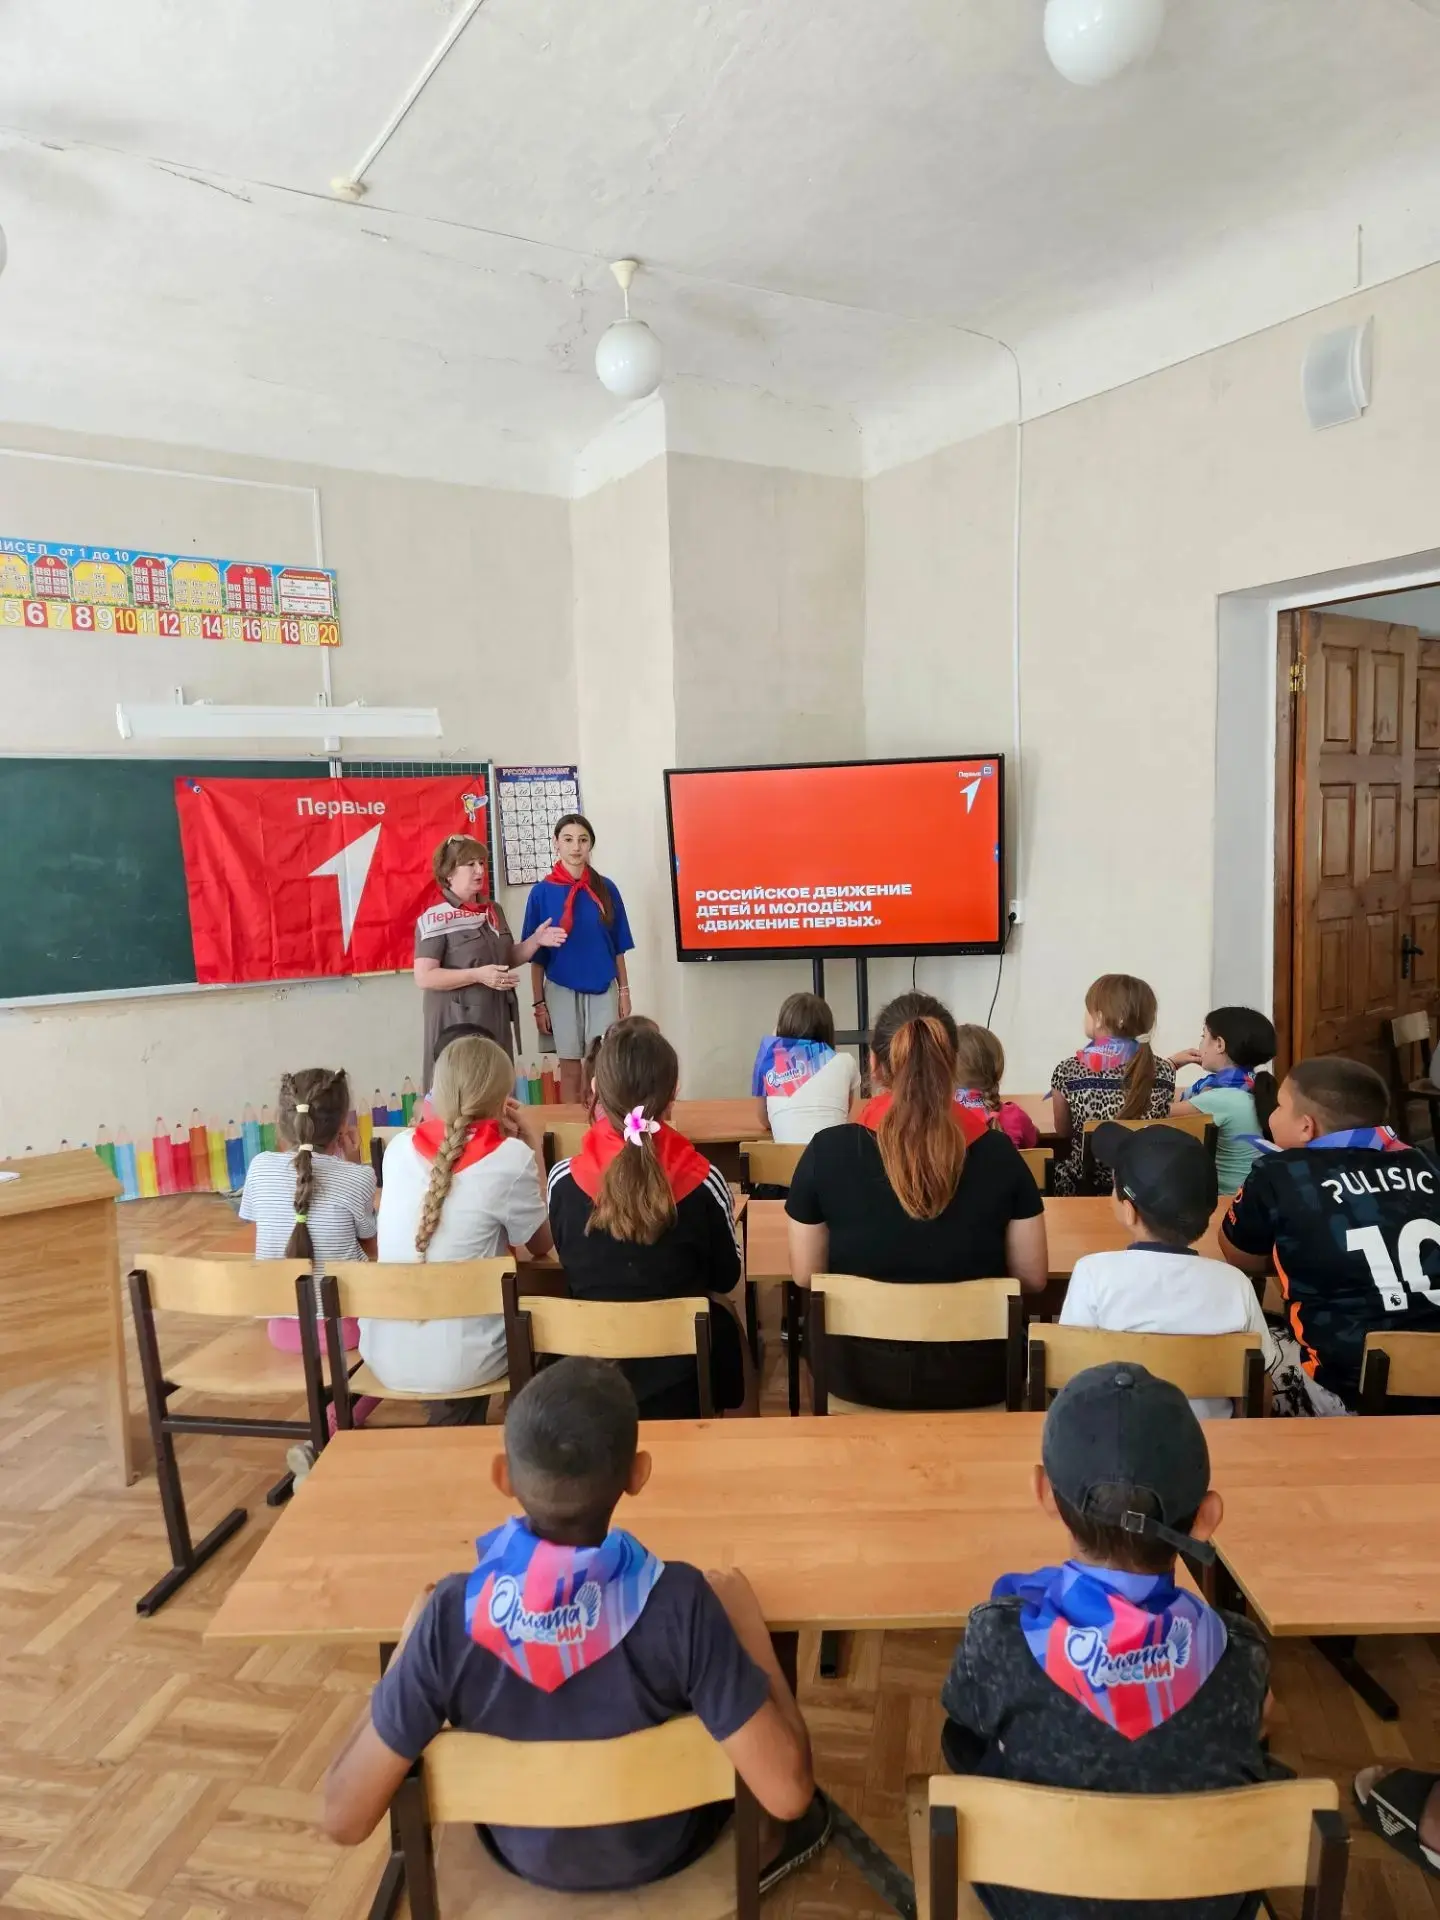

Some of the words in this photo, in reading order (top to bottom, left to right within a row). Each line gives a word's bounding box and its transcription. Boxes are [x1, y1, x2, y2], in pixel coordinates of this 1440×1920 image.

[60, 548, 74, 557] от
[80, 547, 85, 558] 1
[93, 551, 110, 561] до
[114, 550, 129, 562] 10
[4, 601, 21, 623] 5
[27, 602, 45, 625] 6
[52, 604, 67, 626] 7
[76, 606, 92, 628] 8
[96, 608, 113, 630] 9
[115, 609, 136, 631] 10
[140, 610, 156, 633] 11
[160, 613, 180, 635] 12
[182, 615, 200, 637] 13
[202, 616, 222, 637] 14
[224, 618, 242, 639] 15
[243, 619, 261, 640] 16
[262, 620, 280, 641] 17
[282, 622, 299, 642] 18
[302, 623, 318, 643] 19
[319, 624, 338, 644] 20
[297, 797, 386, 819] Первые
[695, 886, 810, 901] РОССИЙСКОЕ
[813, 884, 912, 899] ДВИЖЕНИЕ
[696, 901, 751, 918] ДЕТЕЙ
[754, 903, 766, 915] И
[769, 898, 872, 915] МОЛОДЁЖИ
[698, 918, 800, 932] «ДВИЖЕНИЕ
[802, 915, 882, 929] ПЕРВЫХ»
[1346, 1218, 1440, 1312] 10
